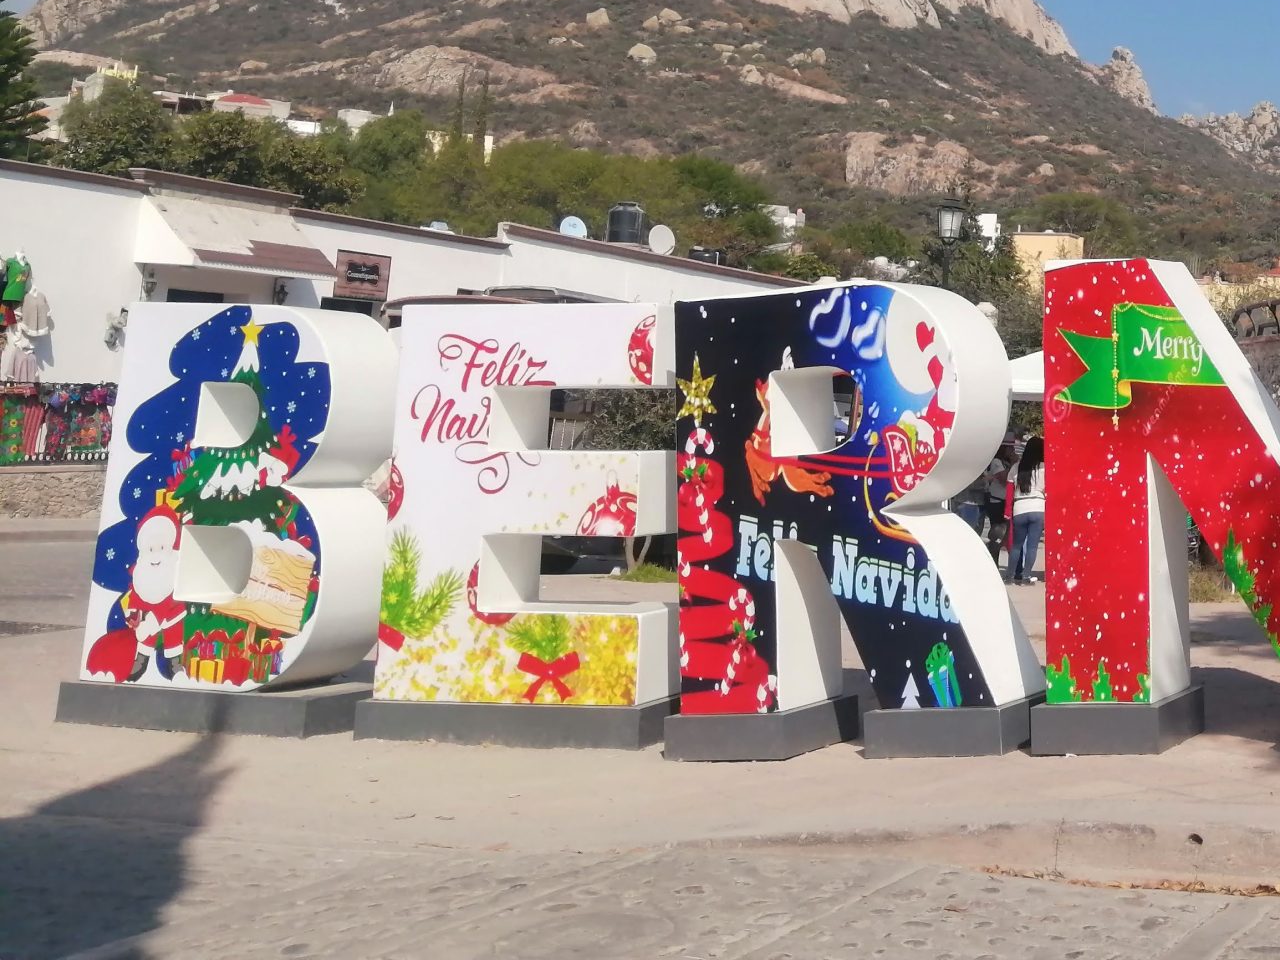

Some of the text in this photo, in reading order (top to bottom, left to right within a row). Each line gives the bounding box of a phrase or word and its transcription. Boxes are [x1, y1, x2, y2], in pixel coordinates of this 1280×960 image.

[438, 334, 557, 392] Feliz
[1133, 326, 1203, 376] Merry
[831, 534, 959, 624] Navida
